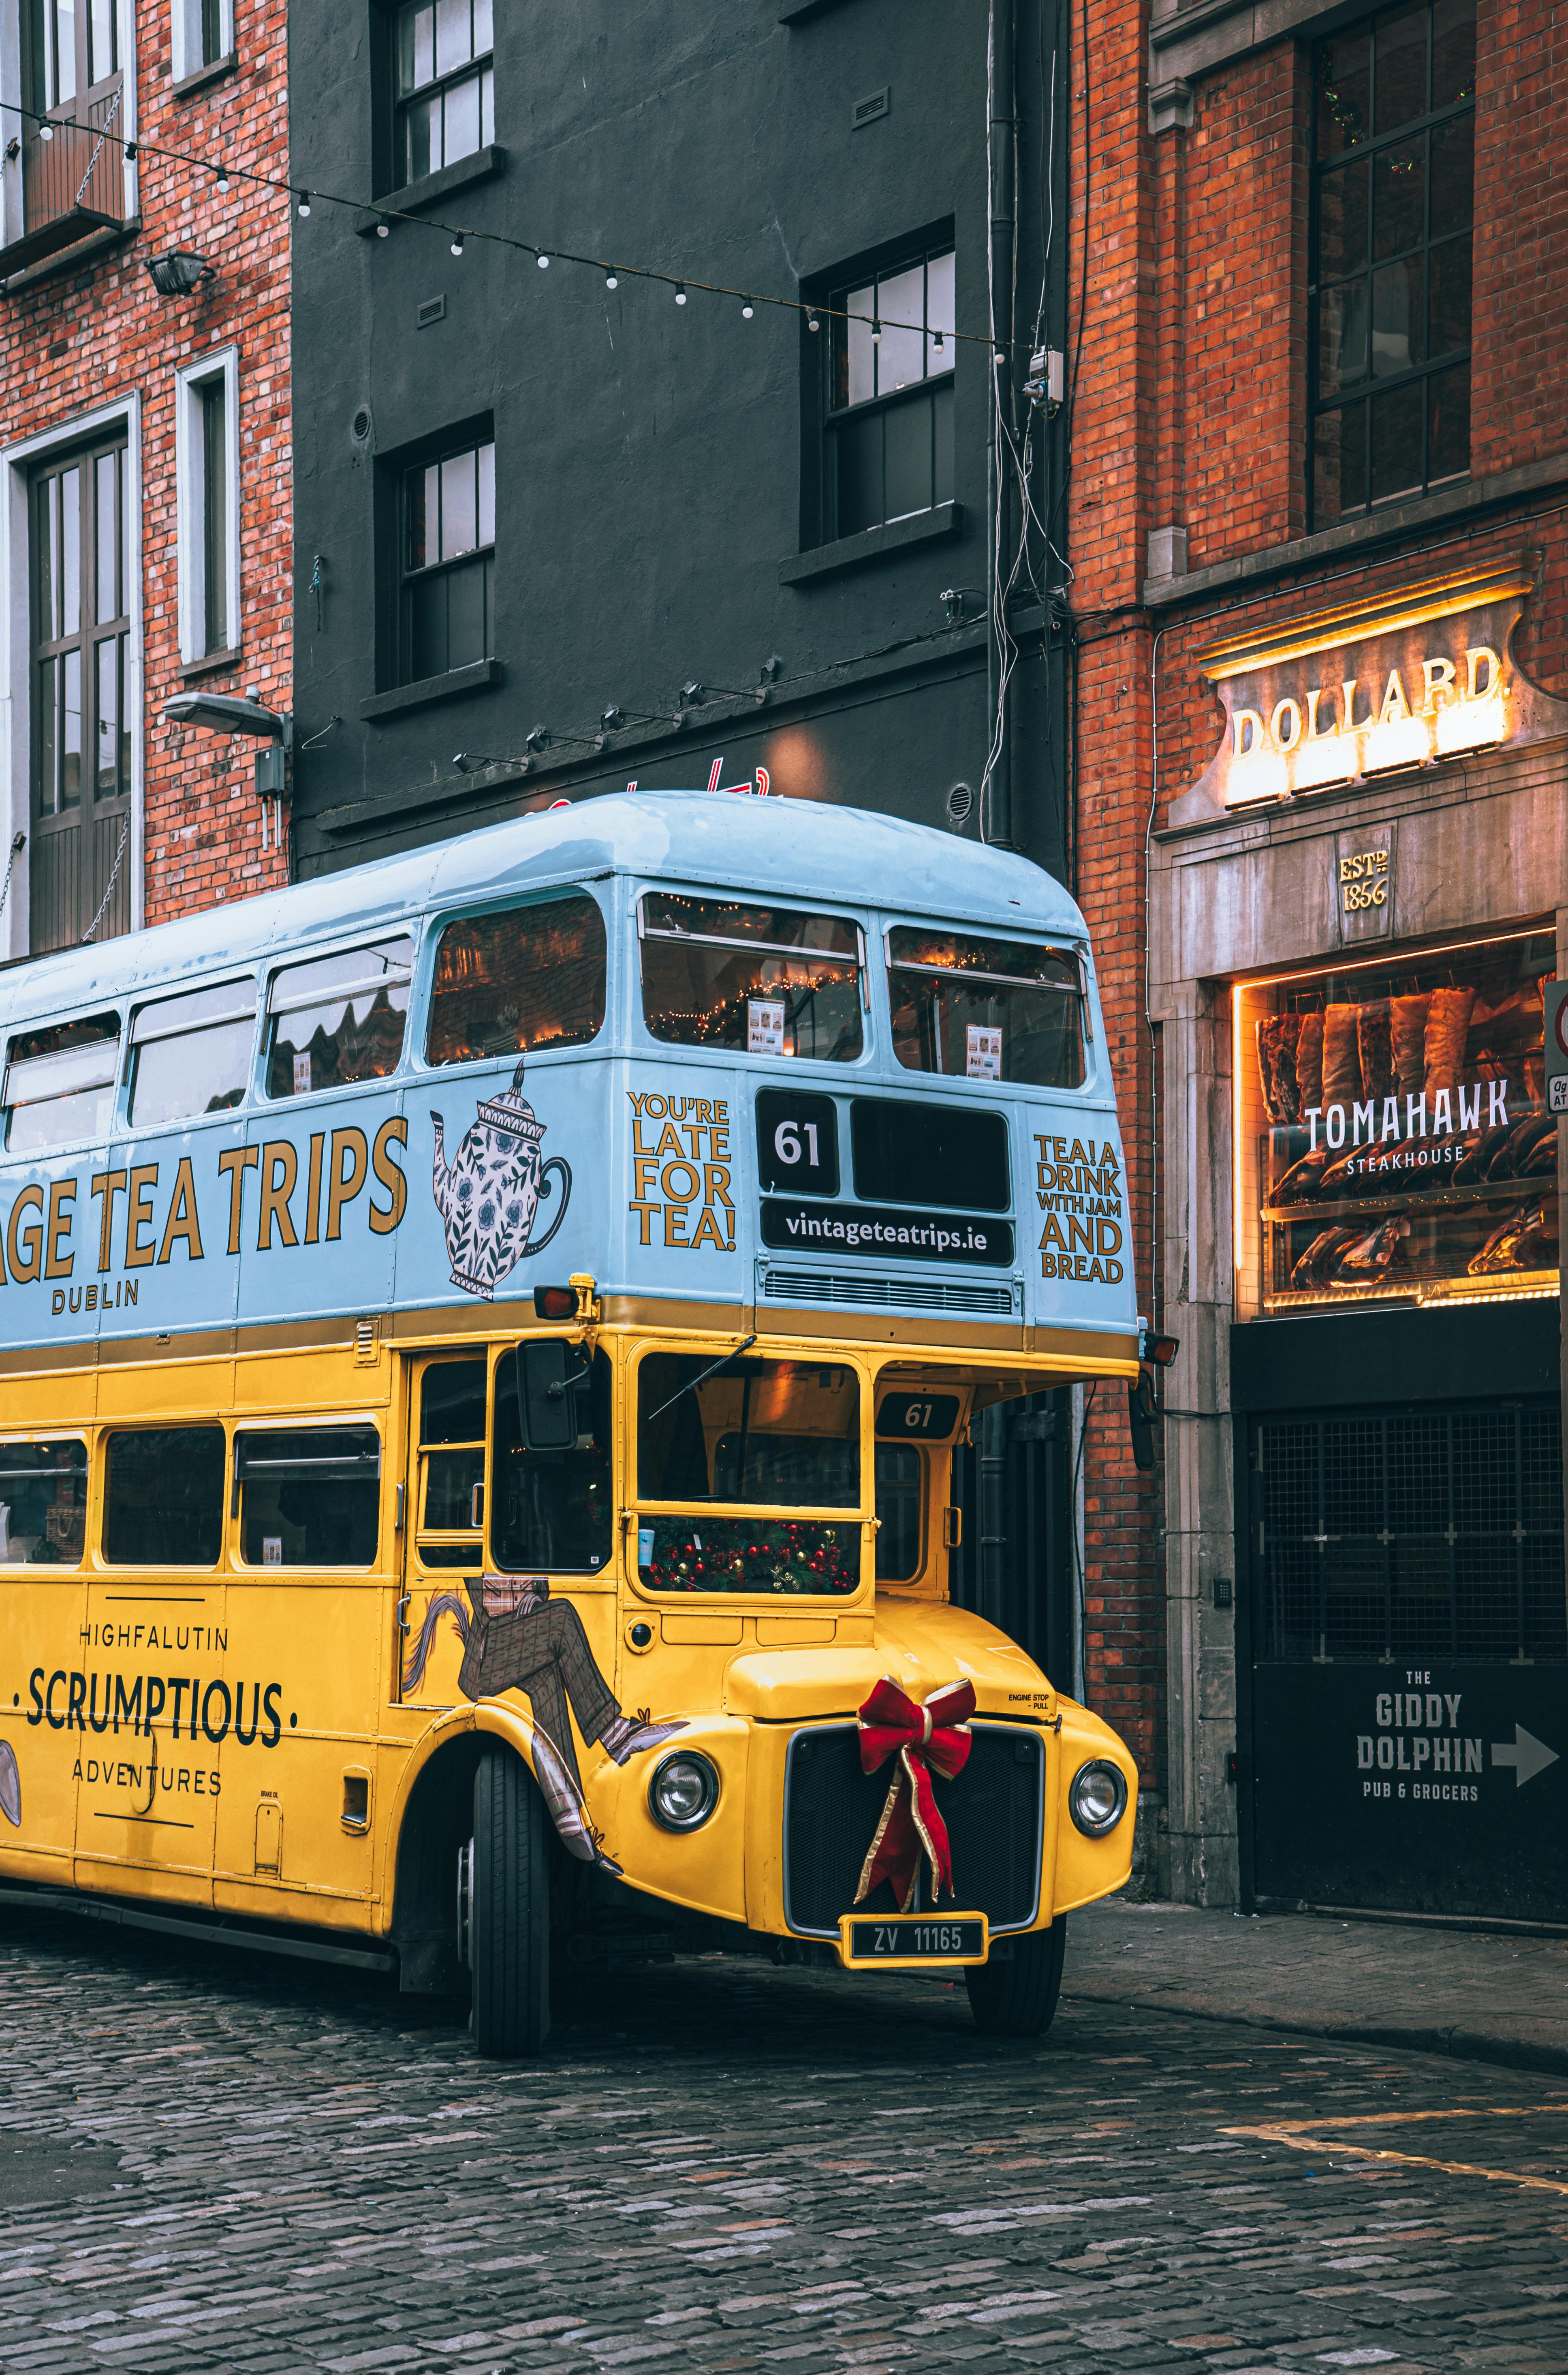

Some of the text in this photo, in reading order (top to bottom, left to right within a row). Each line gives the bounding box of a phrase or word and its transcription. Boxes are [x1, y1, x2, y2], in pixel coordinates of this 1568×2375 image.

[1343, 878, 1387, 911] 1856
[626, 1092, 729, 1125] YOU'RE
[1304, 1079, 1509, 1151] TOMAHAWK
[1554, 1094, 1567, 1106] AT
[632, 1119, 732, 1163] LATE
[774, 1121, 819, 1166] 61
[1034, 1134, 1119, 1169] TEA! A
[1347, 1146, 1463, 1175] STEAKHOUSE
[633, 1157, 736, 1208] FOR
[1036, 1162, 1122, 1198] DRINK
[0, 1115, 409, 1286] GE TEA TRIPS
[1035, 1192, 1122, 1218] WITH JAM
[629, 1201, 736, 1252] TEA!
[786, 1212, 987, 1252] vintageteatrips.ie
[1037, 1213, 1123, 1256] AND
[1041, 1252, 1124, 1284] BREAD
[52, 1279, 139, 1315] DUBLIN
[905, 1404, 932, 1427] 61
[79, 1623, 228, 1652] HIGHFALUTIN
[1406, 1671, 1431, 1684] THE
[1376, 1693, 1462, 1728] GIDDY
[1357, 1735, 1483, 1773] DOLPHIN
[71, 1759, 221, 1796] ADVENTURES
[1363, 1782, 1478, 1802] PUB & GROCERS
[875, 1927, 961, 1951] ZV 11165
